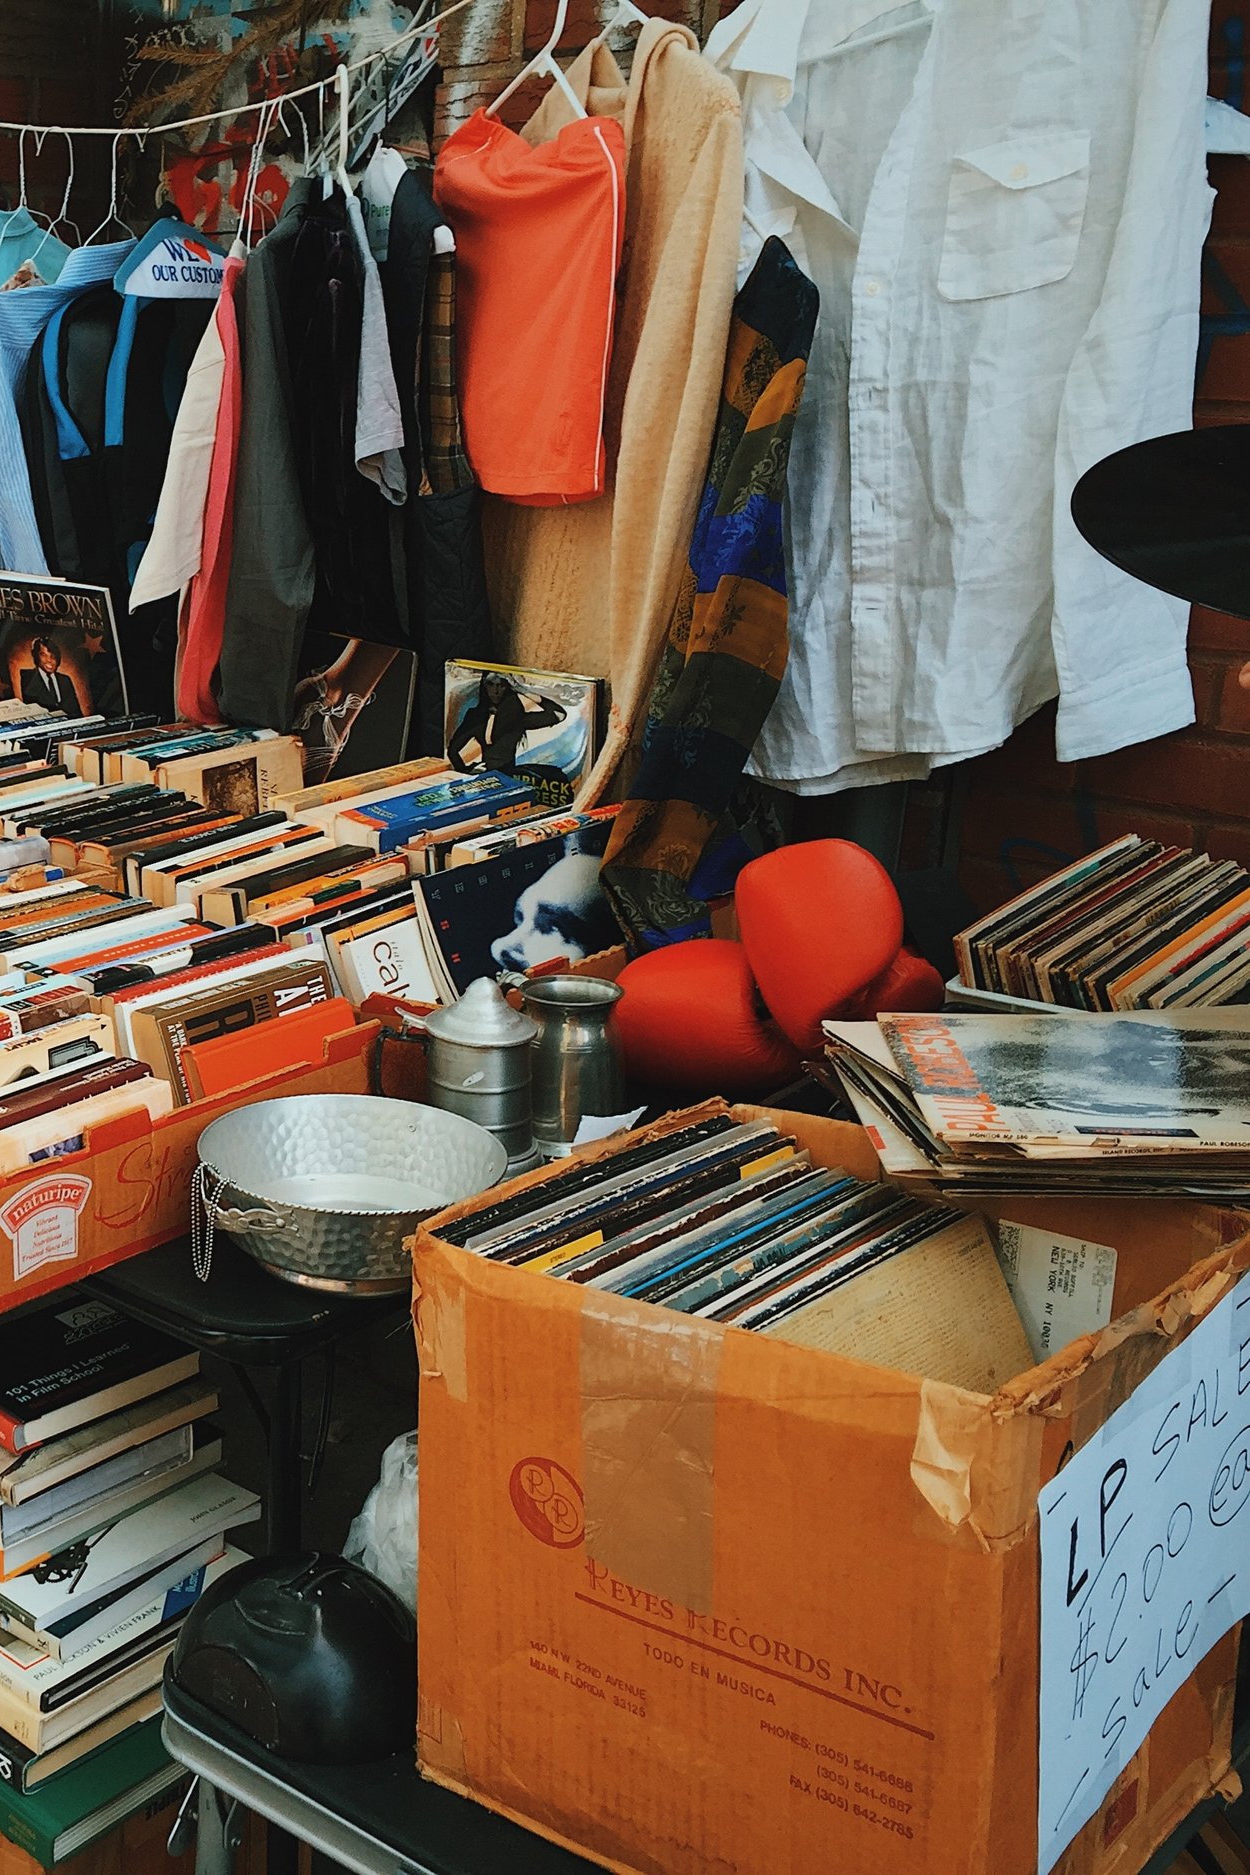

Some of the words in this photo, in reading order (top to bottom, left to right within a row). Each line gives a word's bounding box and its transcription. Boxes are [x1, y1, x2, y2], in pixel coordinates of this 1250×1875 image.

[151, 264, 180, 282] OUR
[8, 610, 31, 623] Time
[35, 614, 78, 628] Greatest
[27, 591, 103, 619] BROWN
[933, 1092, 1011, 1132] PAUL
[1199, 1140, 1218, 1148] PAUL
[11, 1184, 83, 1221] naturipe
[1050, 1246, 1060, 1264] NEW
[1048, 1270, 1057, 1293] YORK
[1045, 1302, 1053, 1316] NY
[5, 1382, 29, 1398] 101
[29, 1363, 73, 1396] Things
[81, 1343, 131, 1368] Learned
[17, 1390, 30, 1404] in
[31, 1379, 62, 1399] Film
[62, 1364, 105, 1388] School
[1066, 1457, 1128, 1608] LP
[33, 1661, 59, 1682] PAUL
[58, 1640, 97, 1670] JACKSON
[97, 1633, 105, 1646] &
[105, 1621, 133, 1641] VIVIEN
[132, 1604, 162, 1627] FRANK
[583, 1555, 674, 1621] REYES
[685, 1607, 832, 1682] RECORDS
[843, 1667, 912, 1715] INC.
[529, 1639, 548, 1655] 140
[575, 1658, 602, 1680] 22ND
[605, 1674, 647, 1702] AVENUE
[643, 1642, 684, 1669] TODO
[691, 1661, 710, 1681] EN
[716, 1671, 777, 1706] MUSICA
[563, 1672, 606, 1701] FLORIDA
[613, 1694, 647, 1719] 33125
[759, 1719, 812, 1752] PHONES:
[815, 1742, 850, 1768] (305)
[789, 1773, 812, 1796] FAX
[815, 1786, 849, 1813] (305)
[816, 1764, 851, 1791] (305)
